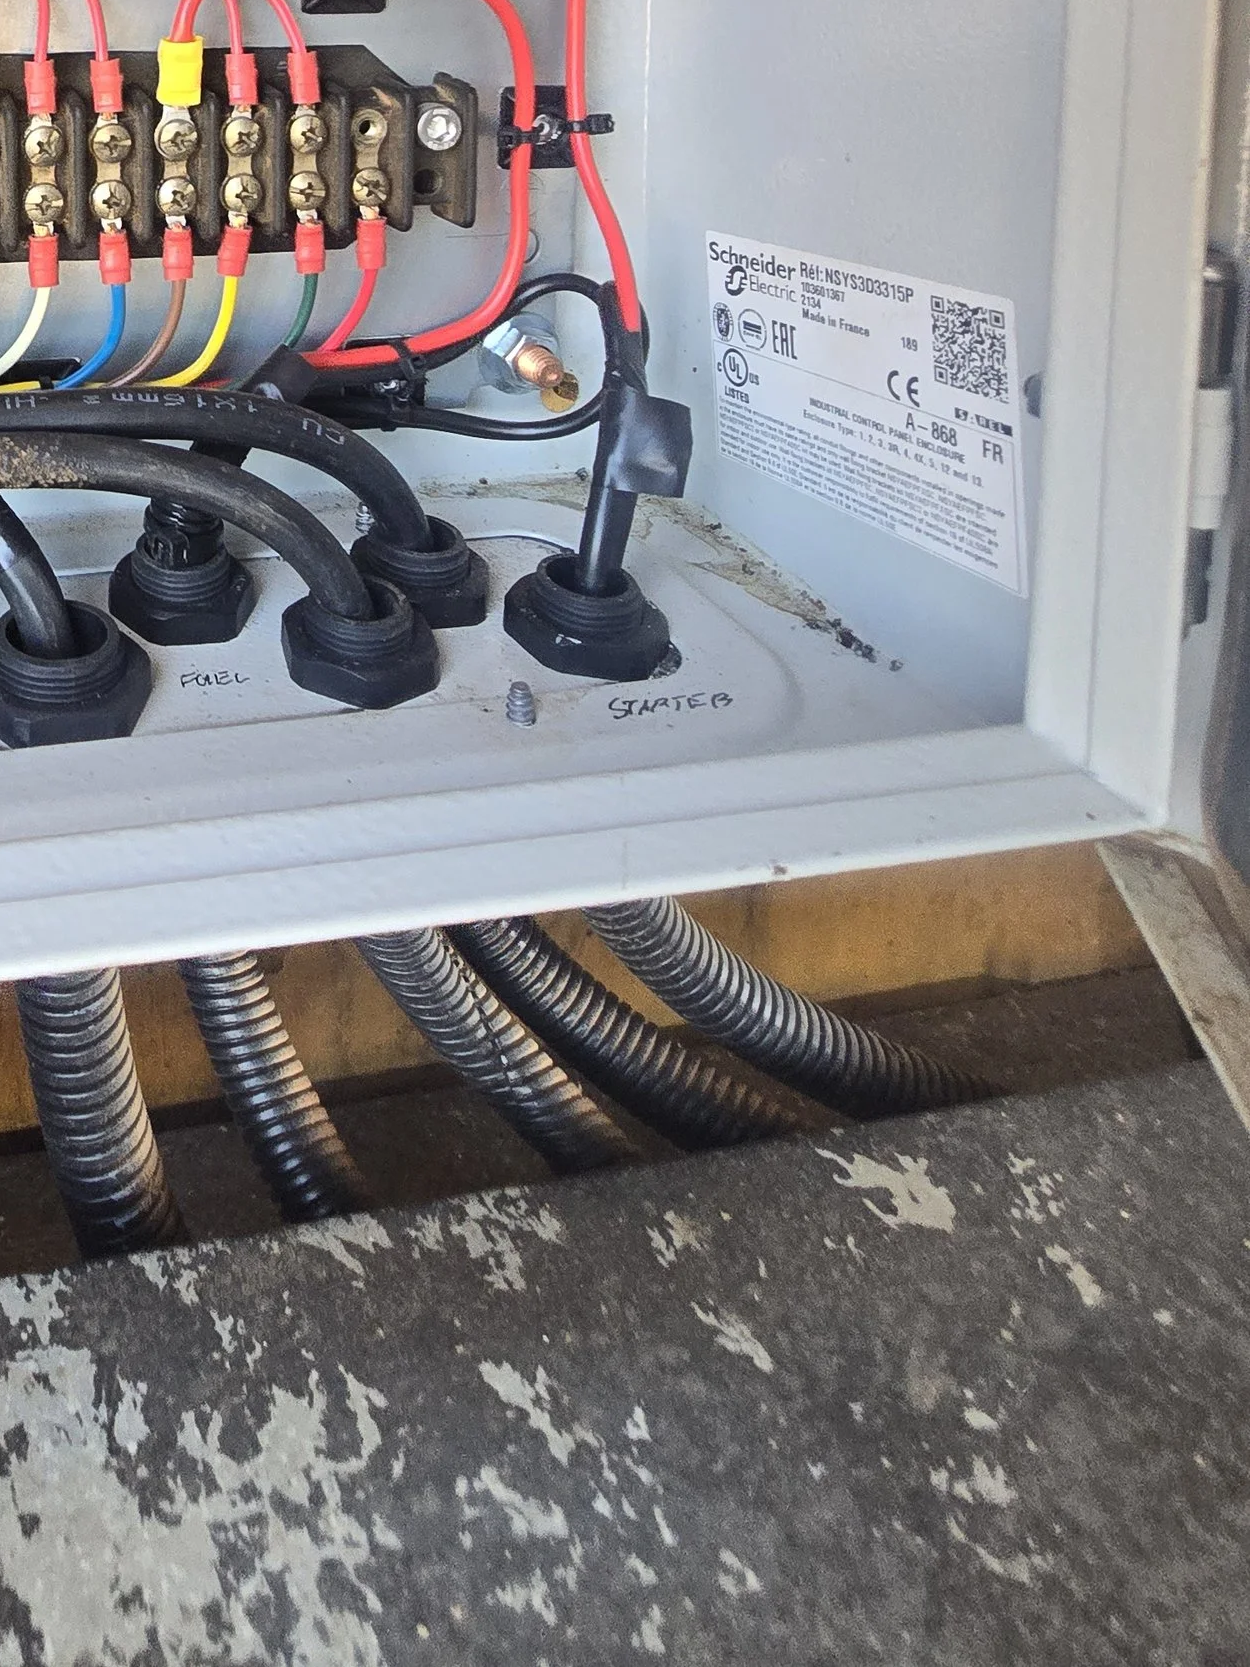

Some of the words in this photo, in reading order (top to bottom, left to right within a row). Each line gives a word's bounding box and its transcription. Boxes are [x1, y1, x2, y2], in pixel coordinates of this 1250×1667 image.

[709, 241, 796, 280] Schneider
[750, 274, 797, 303] Electric
[801, 294, 821, 310] 2134
[802, 308, 826, 325] Made
[828, 315, 837, 328] in
[839, 318, 870, 337] France
[900, 336, 918, 352] 189
[724, 385, 750, 404] LISTED
[803, 409, 835, 429] Enclosure
[809, 397, 851, 421] INDUSTRIAL
[852, 413, 887, 435] CONTROL
[889, 426, 914, 445] PANEL
[916, 437, 966, 465] ENCLOSURE
[982, 439, 1004, 465] FR
[608, 692, 733, 720] STARTER
